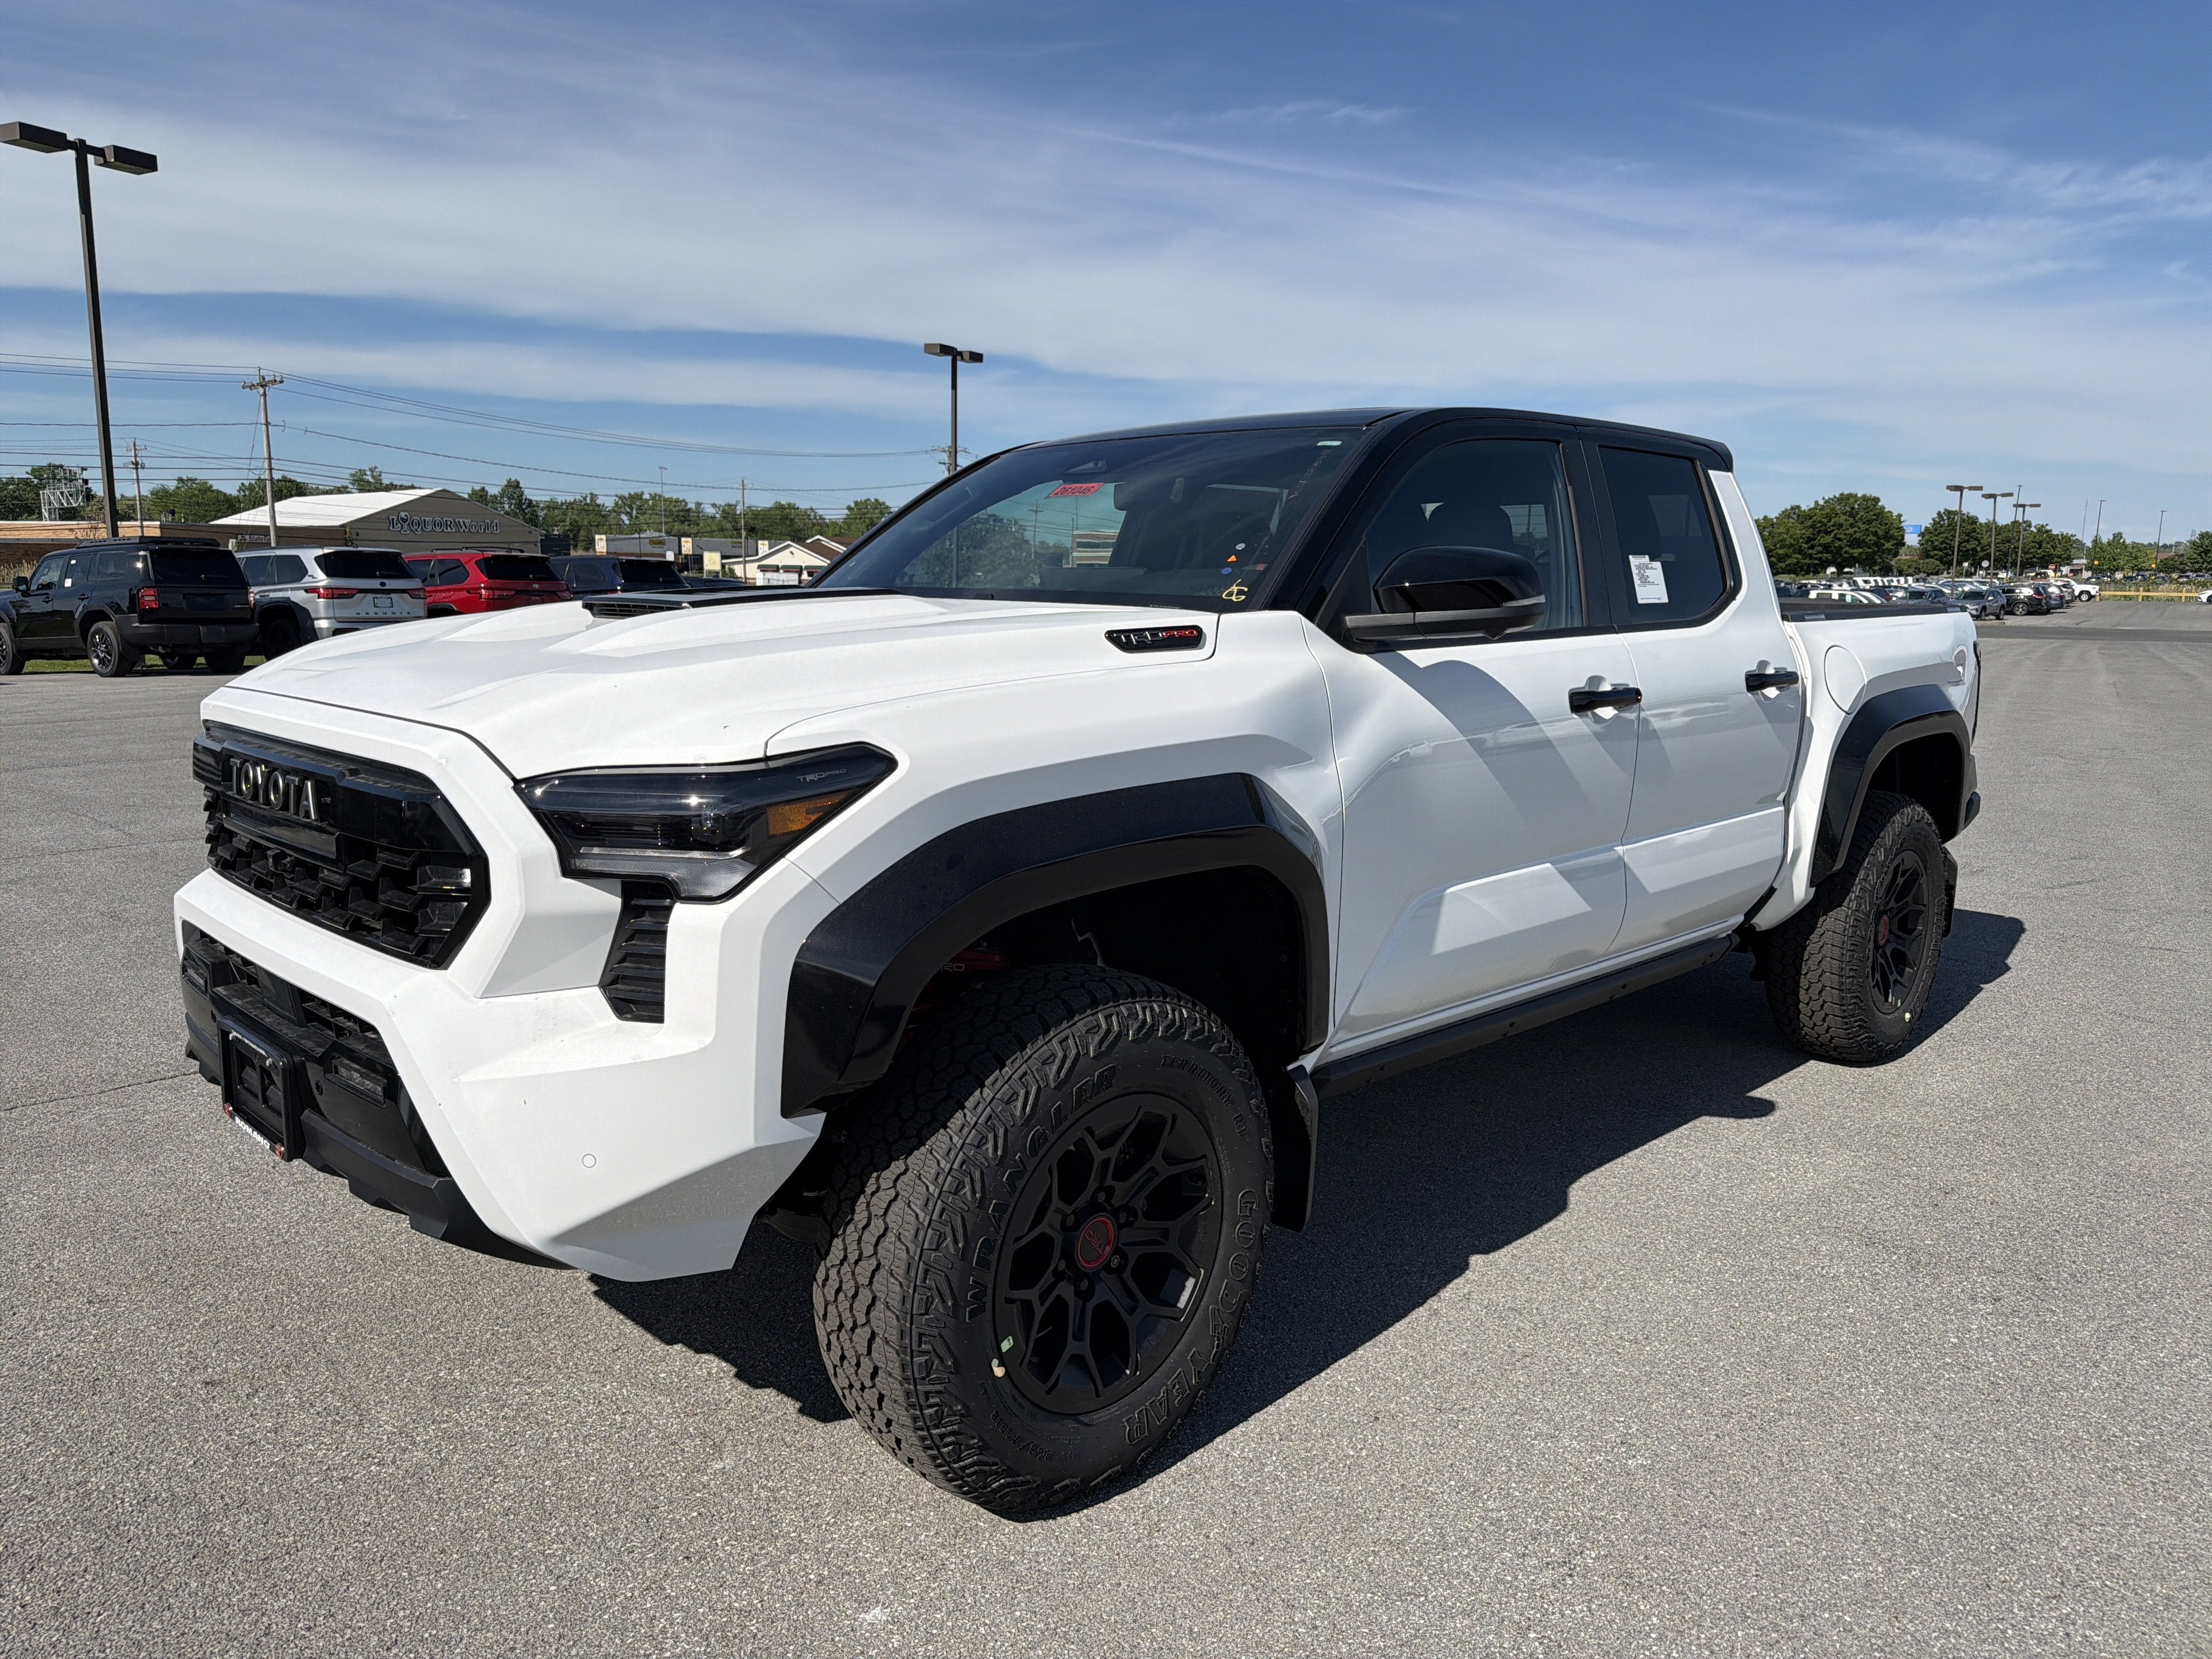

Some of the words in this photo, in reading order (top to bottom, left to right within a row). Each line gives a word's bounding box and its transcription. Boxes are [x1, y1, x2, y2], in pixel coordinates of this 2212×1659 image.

[457, 520, 500, 533] World
[1113, 630, 1164, 645] TRD
[230, 758, 319, 821] TOYOTA
[796, 772, 825, 782] TRD
[940, 963, 965, 973] RD
[1159, 1054, 1234, 1107] TERRITORY
[1232, 1112, 1249, 1136] RT
[235, 1116, 270, 1149] ROMANO
[966, 1063, 1116, 1324] WRANGLER
[1084, 1229, 1103, 1255] TRD
[1123, 1188, 1259, 1445] GOODYEAR
